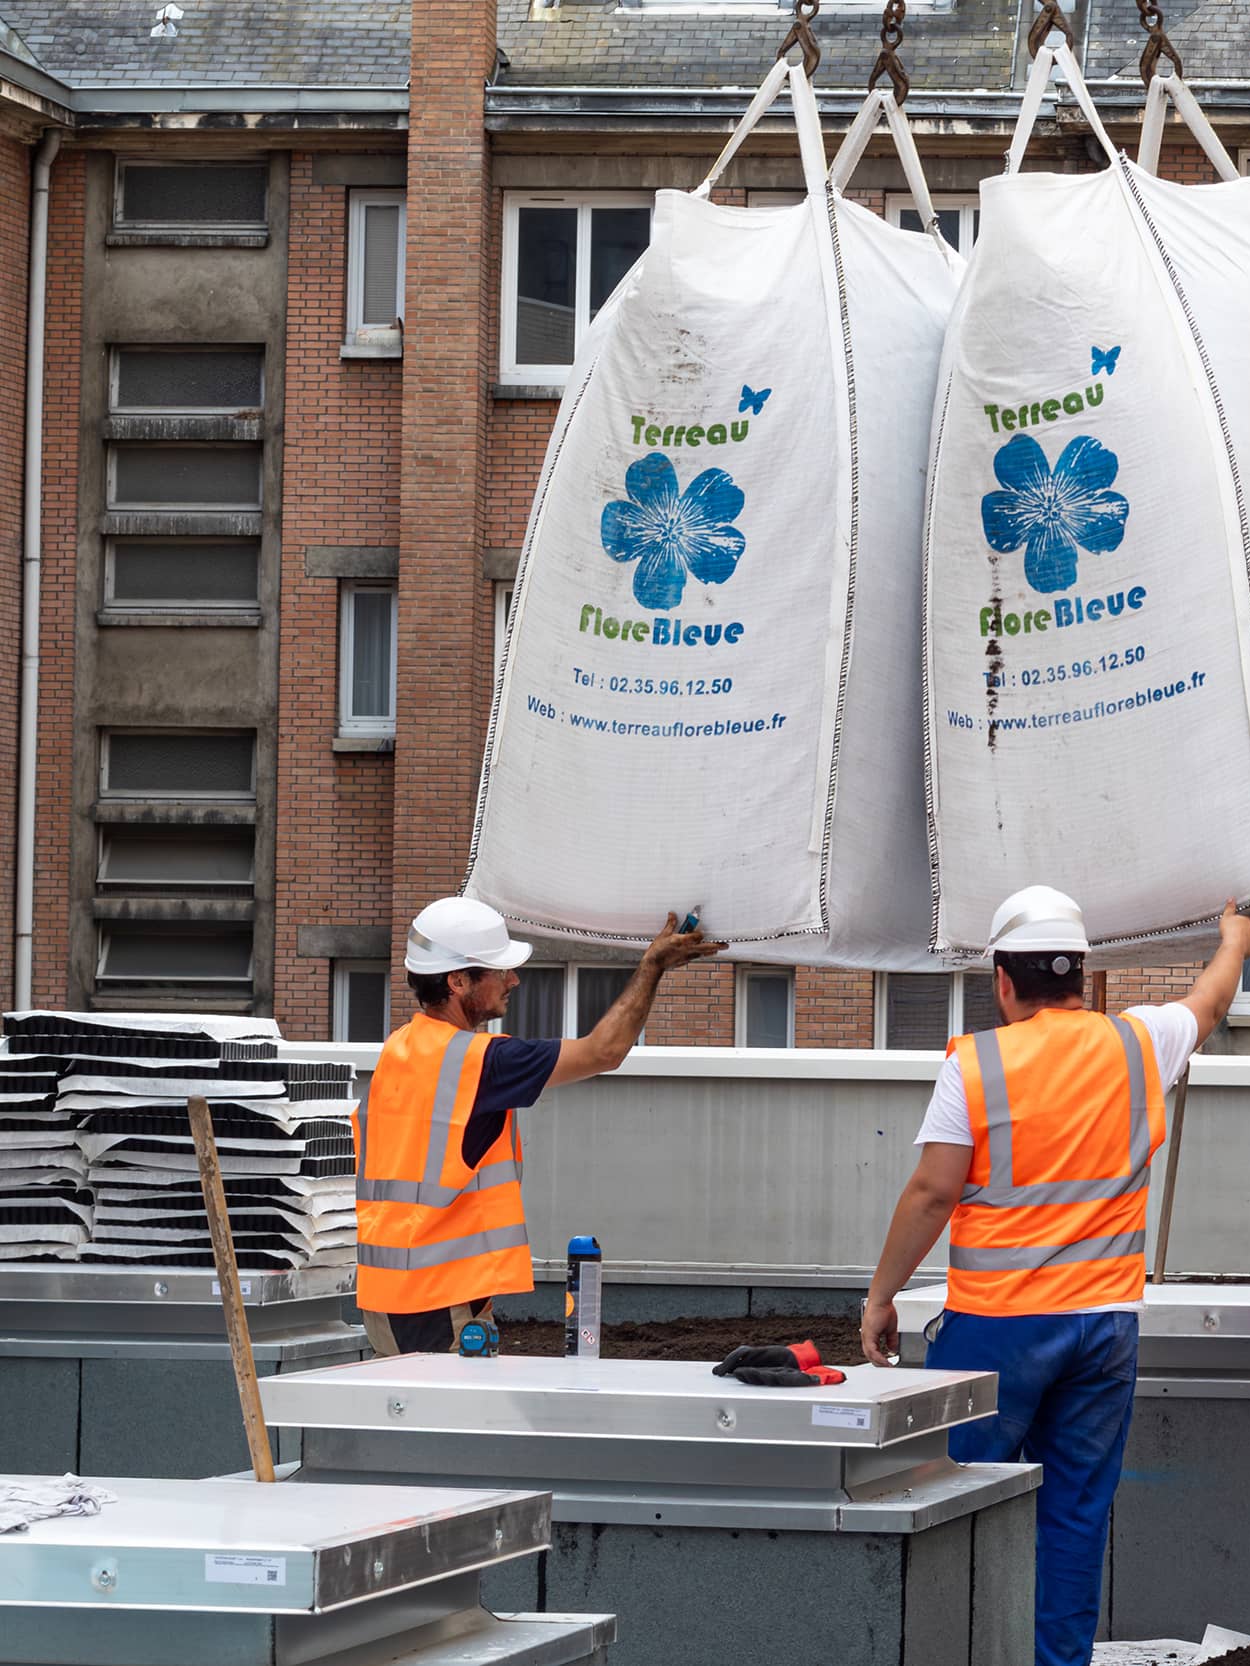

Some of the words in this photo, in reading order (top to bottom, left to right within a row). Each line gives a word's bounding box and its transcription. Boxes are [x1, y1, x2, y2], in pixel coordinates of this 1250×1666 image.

[984, 383, 1104, 433] Terreau
[631, 415, 750, 447] Terreau
[573, 668, 595, 687] Tel
[609, 677, 733, 696] 02.35.96.12.50
[1021, 645, 1146, 687] 02.35.96.12.50
[527, 695, 556, 720] Web
[570, 713, 788, 738] www.terreauflorebleue.fr
[948, 709, 974, 729] Web
[988, 670, 1206, 731] www.terreauflorebleue.fr
